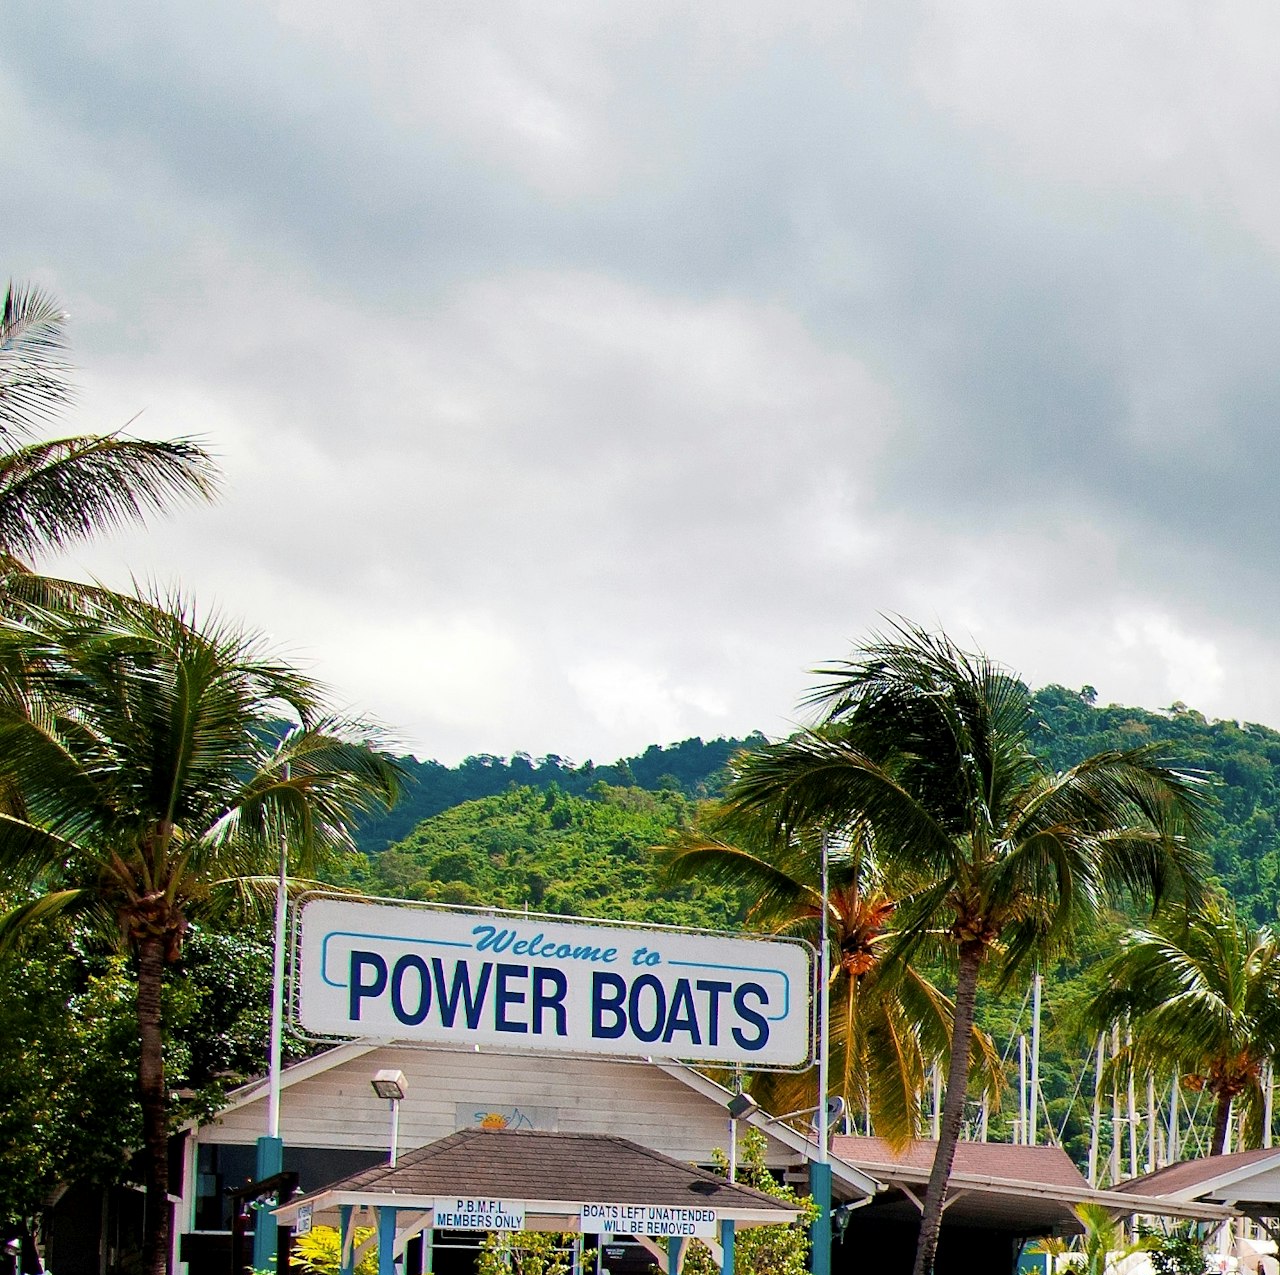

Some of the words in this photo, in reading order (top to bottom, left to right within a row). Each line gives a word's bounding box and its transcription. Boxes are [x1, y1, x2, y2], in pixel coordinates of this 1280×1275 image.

[472, 925, 618, 962] Welcome
[631, 947, 663, 967] to
[349, 950, 568, 1037] POWER
[591, 971, 770, 1051] BOATS
[457, 1200, 507, 1214] P.B.M.F.L.
[583, 1205, 618, 1218] BOATS
[621, 1207, 645, 1219] LEFT
[649, 1207, 715, 1222] UNATTENDED
[437, 1213, 492, 1228] MEMBERS
[495, 1215, 522, 1228] ONLY
[604, 1220, 627, 1233] WILL
[631, 1222, 643, 1233] BE
[647, 1222, 695, 1235] REMOVED
